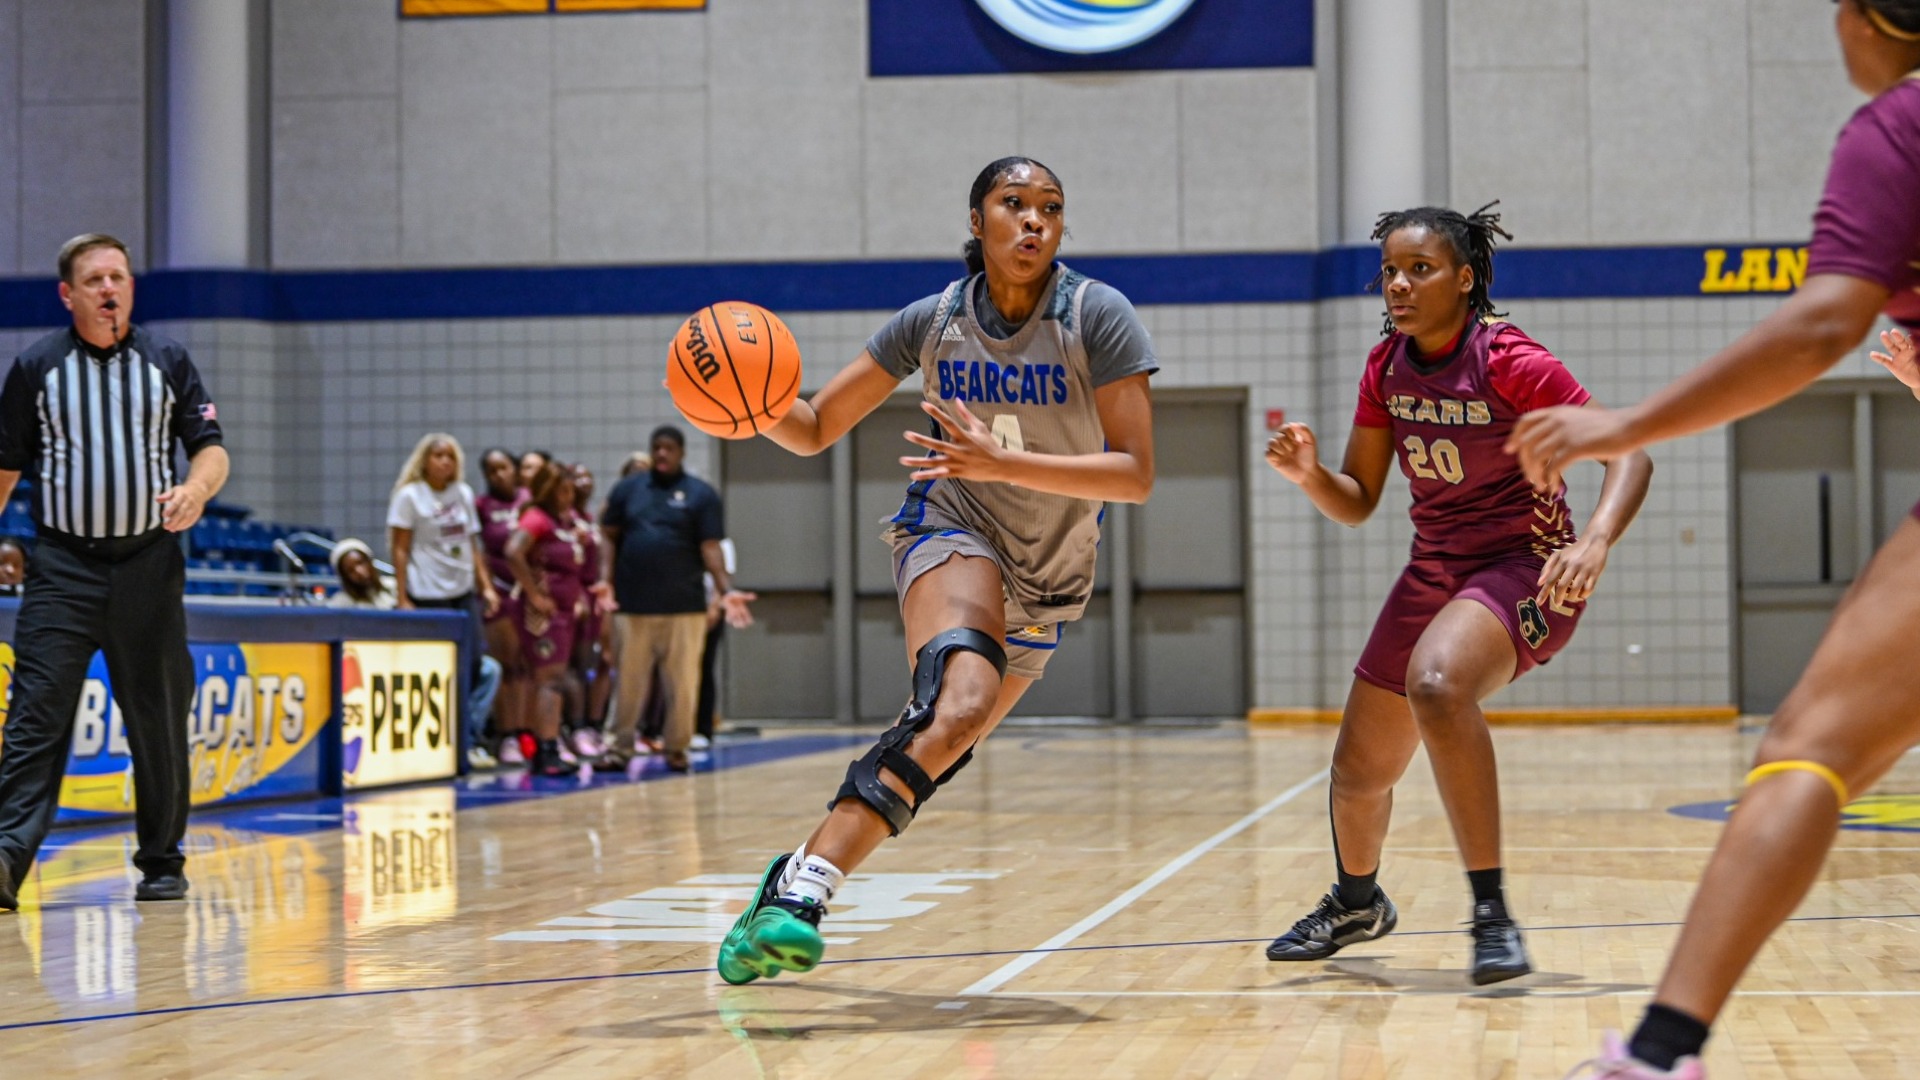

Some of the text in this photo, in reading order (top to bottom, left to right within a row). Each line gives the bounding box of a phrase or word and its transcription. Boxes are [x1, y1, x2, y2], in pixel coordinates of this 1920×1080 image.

[937, 360, 1068, 405] BEARCATS
[1403, 435, 1464, 485] 20
[73, 674, 306, 757] BCATS
[371, 671, 456, 753] PEPSI
